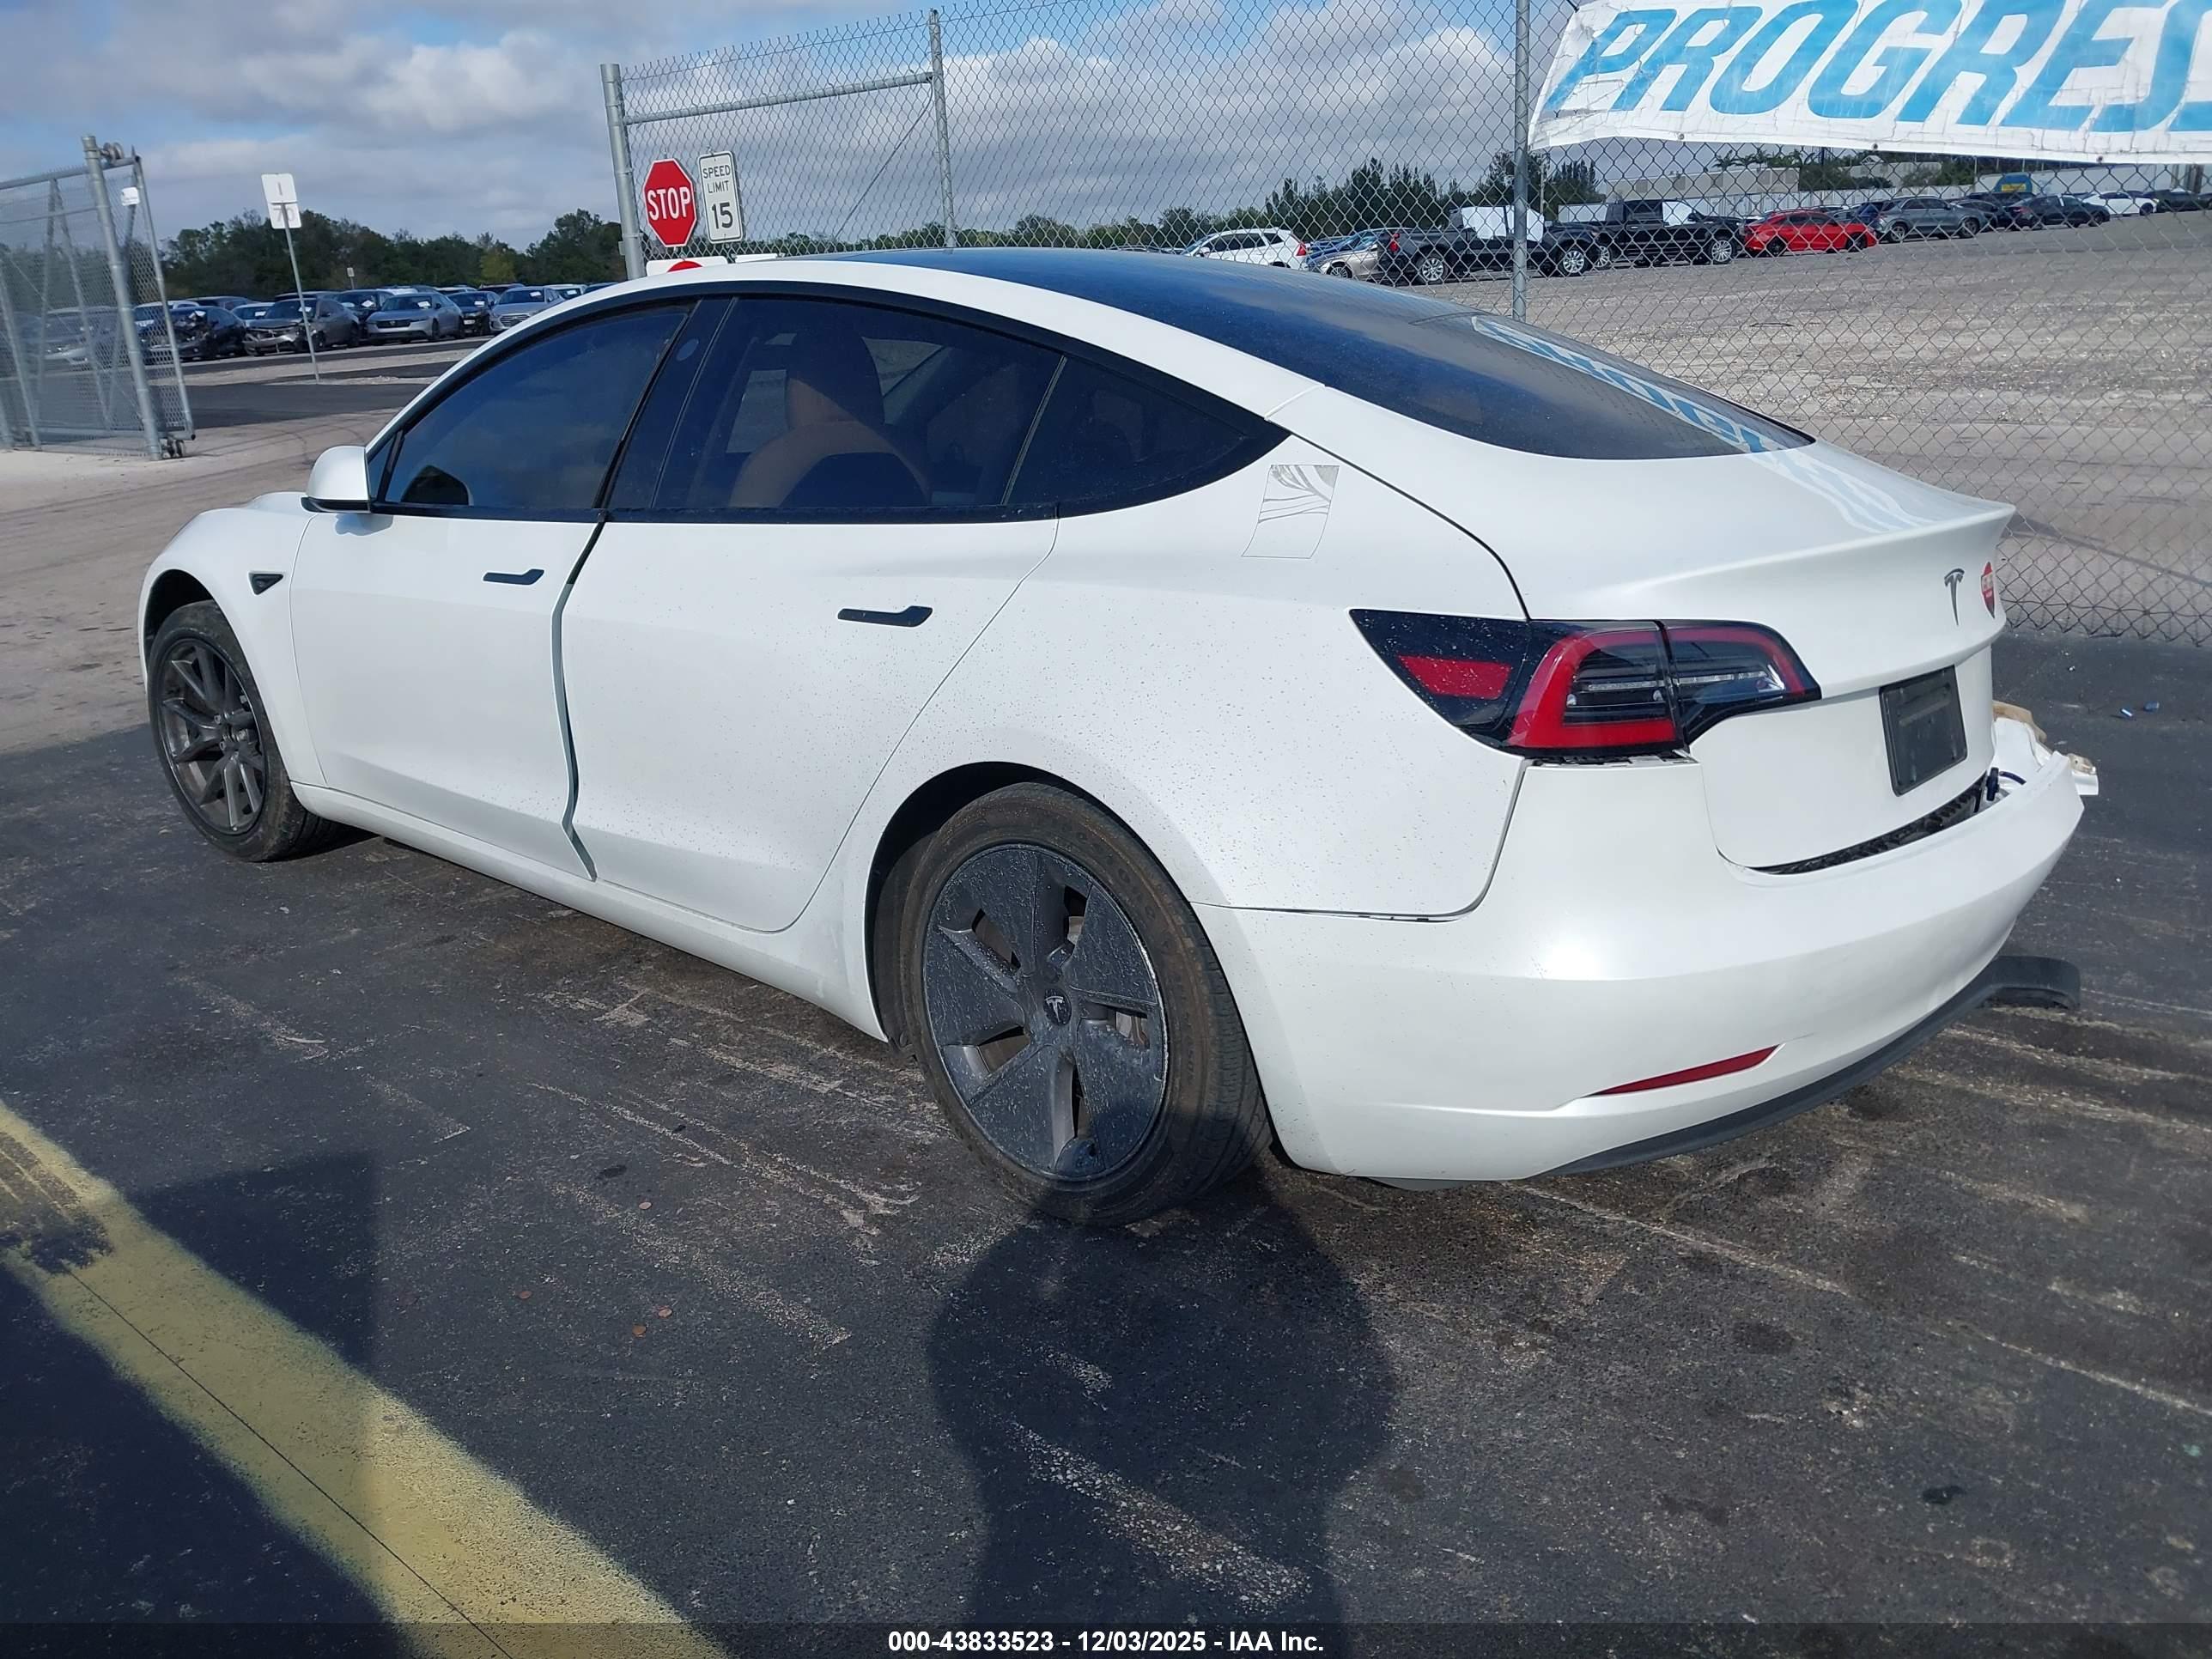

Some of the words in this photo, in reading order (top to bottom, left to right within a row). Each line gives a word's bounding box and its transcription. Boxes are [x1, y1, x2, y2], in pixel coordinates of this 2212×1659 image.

[1544, 0, 2212, 132] PROGRES
[703, 165, 731, 179] SPEED
[708, 180, 730, 193] LIMIT
[647, 186, 690, 221] STOP
[712, 202, 733, 229] 15
